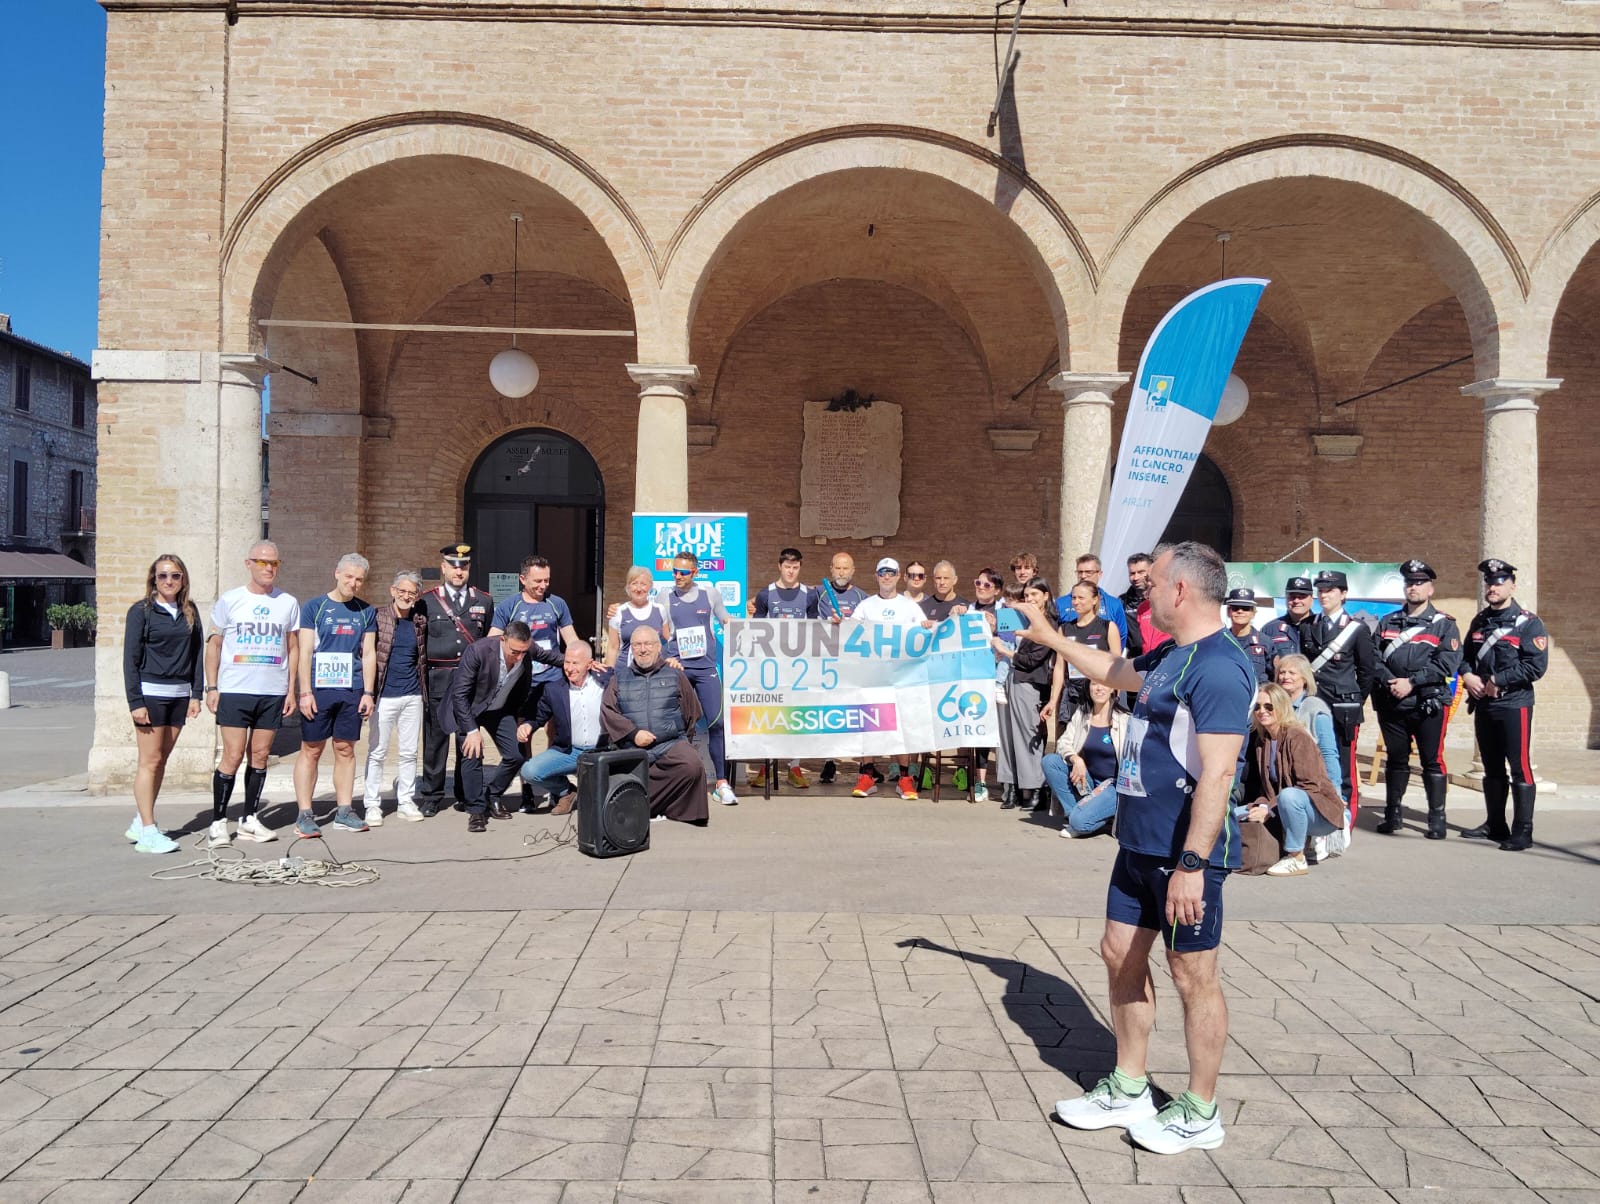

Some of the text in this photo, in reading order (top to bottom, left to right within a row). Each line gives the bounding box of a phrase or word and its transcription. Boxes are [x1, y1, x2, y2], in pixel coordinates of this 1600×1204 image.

[1133, 445, 1199, 462] AFFONTIAM
[1131, 458, 1140, 468] IL
[1128, 471, 1169, 485] INSEME.
[655, 543, 722, 557] 4HOPE
[662, 560, 718, 571] MGEN
[236, 635, 282, 646] 4HOPE
[729, 658, 839, 691] 2025
[730, 693, 784, 703] V EDIZIONE
[747, 708, 881, 731] MASSIGEN
[943, 724, 987, 738] AIRC
[1122, 739, 1138, 764] UN
